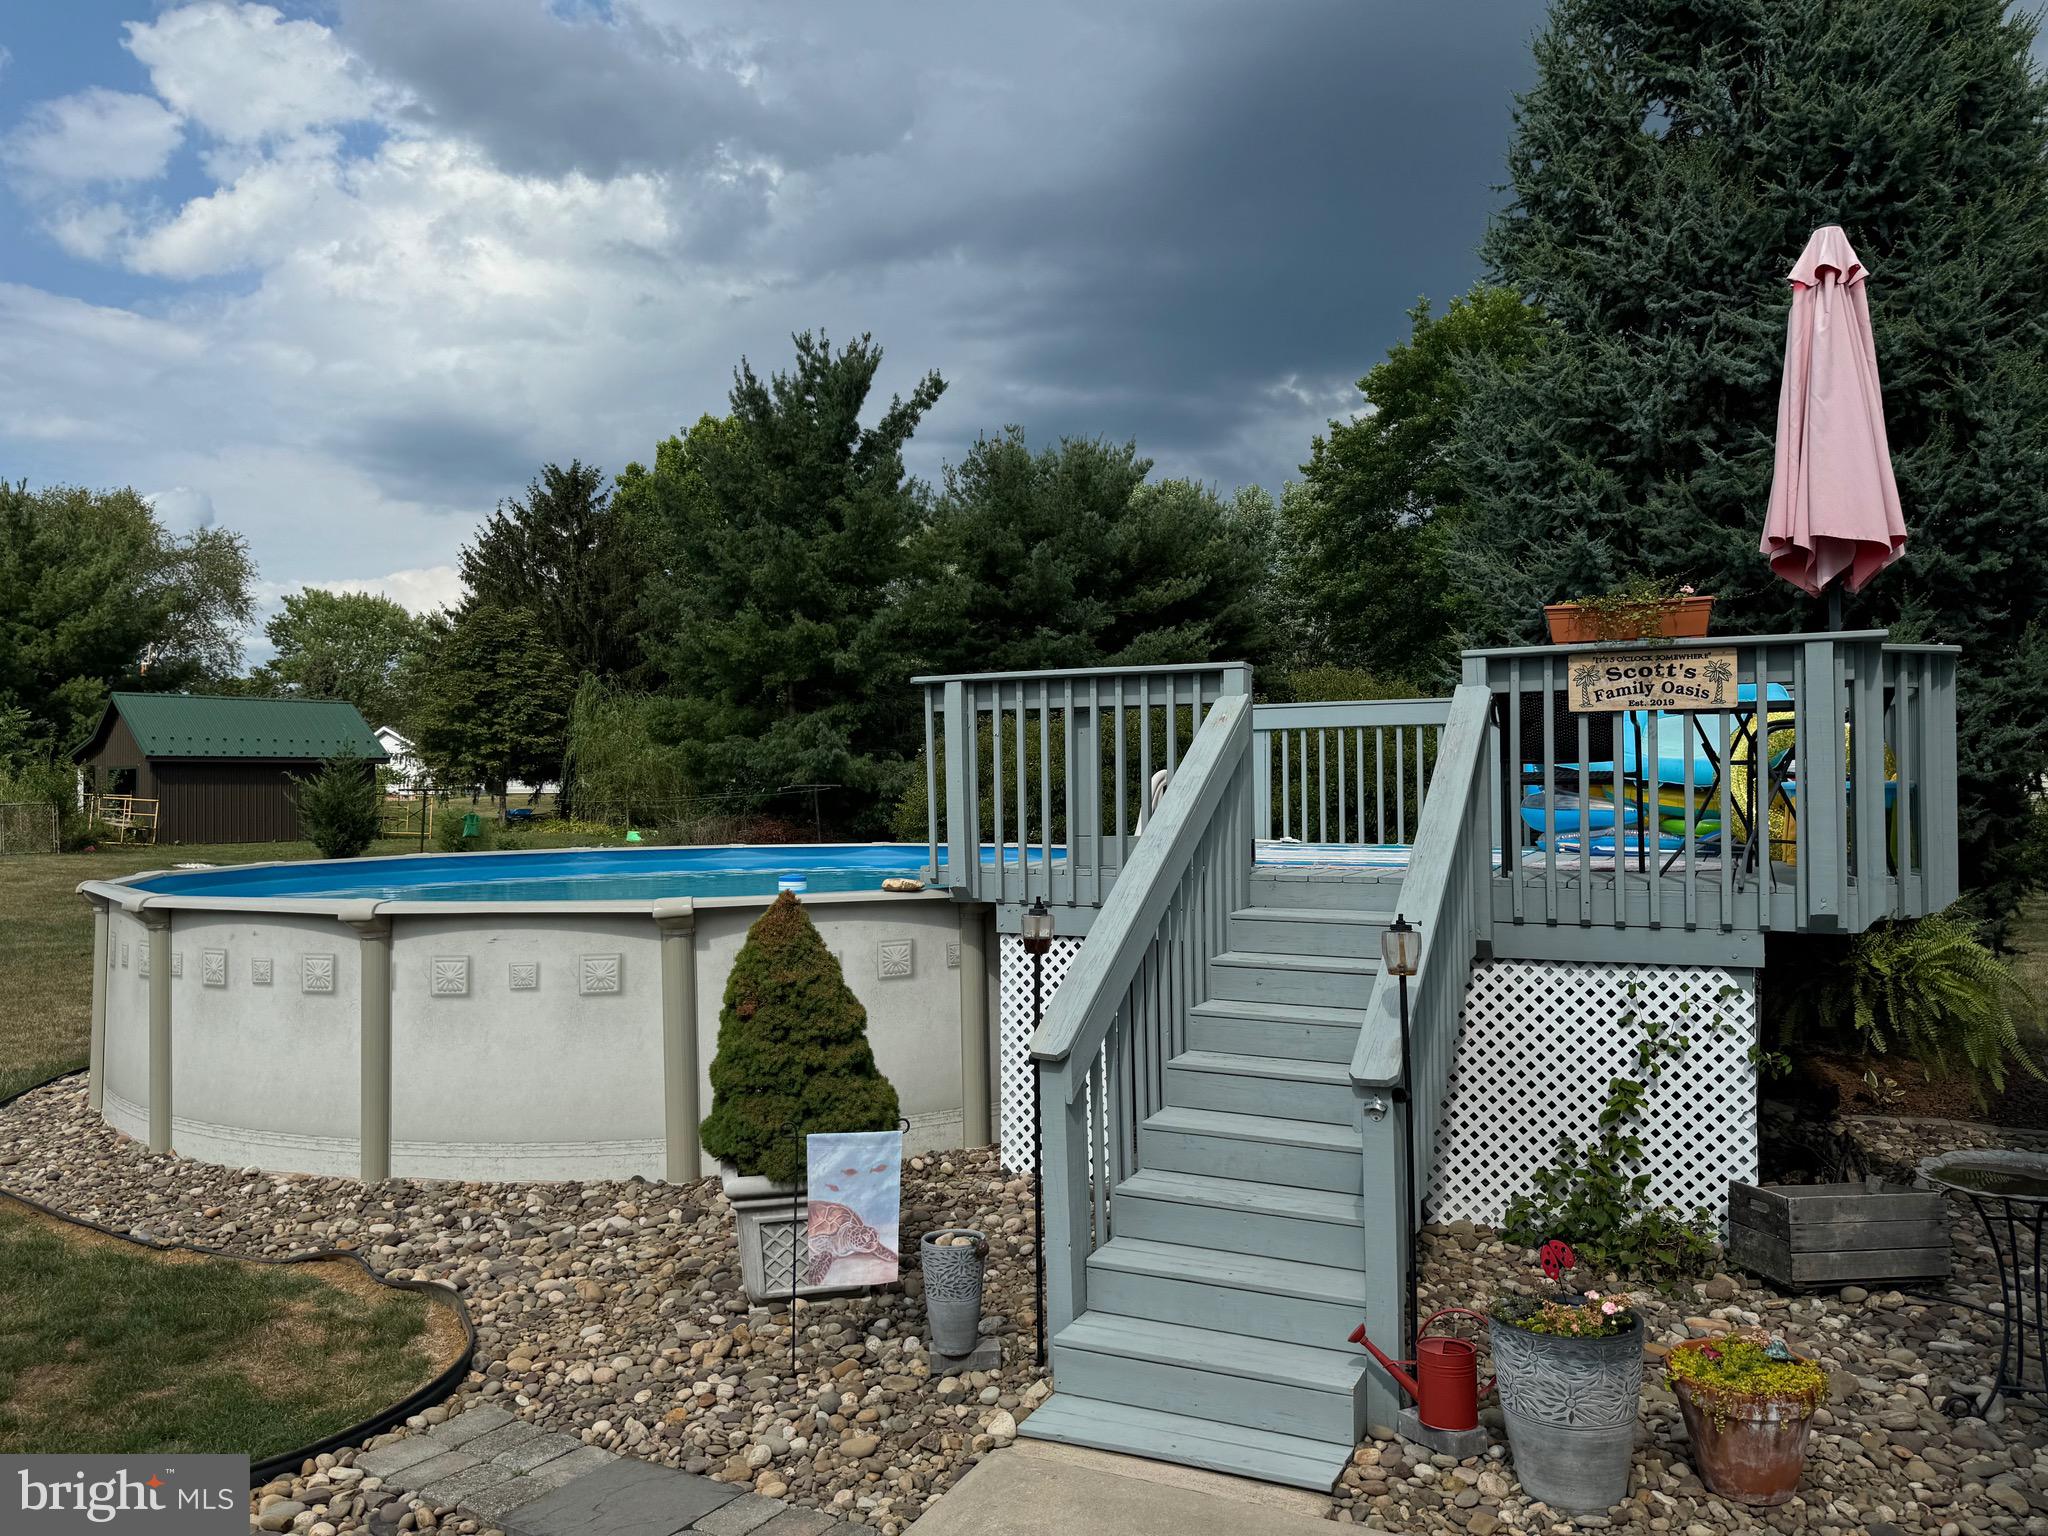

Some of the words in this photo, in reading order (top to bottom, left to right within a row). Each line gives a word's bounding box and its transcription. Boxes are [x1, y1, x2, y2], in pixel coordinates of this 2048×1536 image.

[1616, 655, 1653, 663] O'CLOCK
[1656, 652, 1712, 661] SOMEWHERE"
[1605, 663, 1697, 682] Scott's
[1593, 680, 1655, 703] Family
[1661, 680, 1710, 699] Oasis
[1628, 699, 1647, 707] Est.
[1649, 698, 1675, 706] 2019
